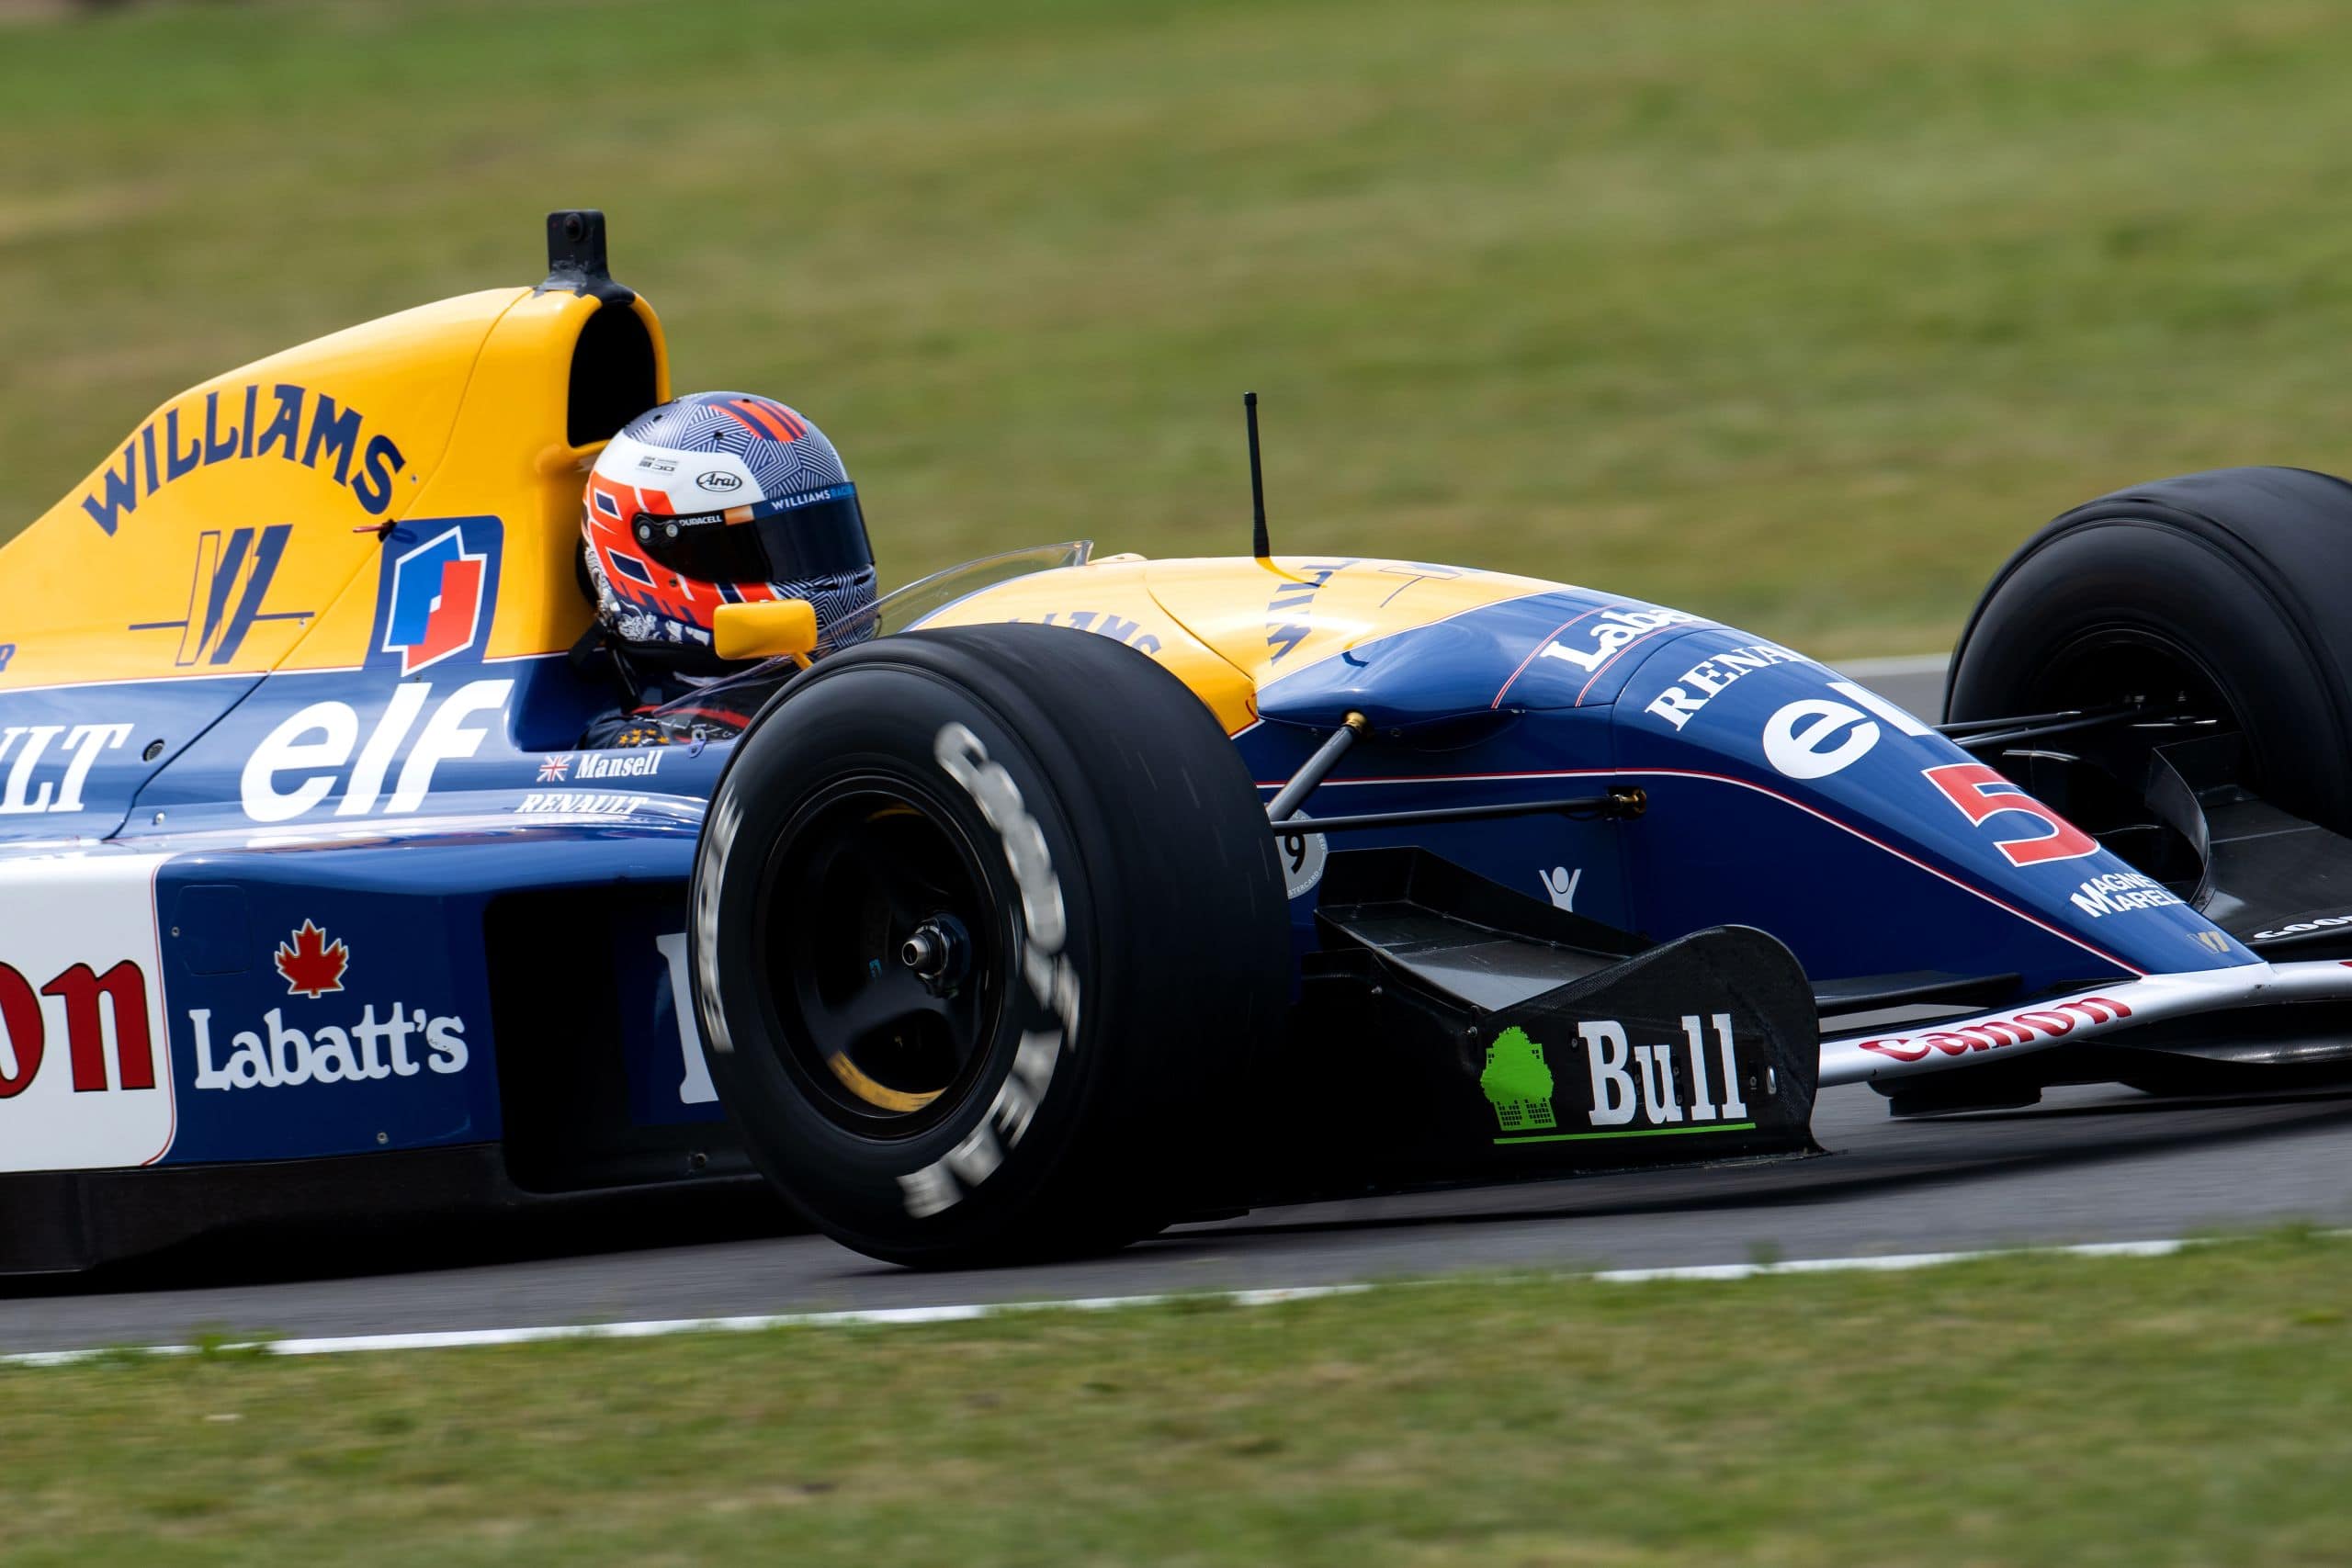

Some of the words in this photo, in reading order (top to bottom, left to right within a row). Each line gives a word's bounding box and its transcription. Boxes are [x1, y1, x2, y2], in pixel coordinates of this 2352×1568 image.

[83, 383, 406, 536] WILLIAMS
[699, 473, 735, 487] Arai
[771, 490, 831, 510] WILLIAMS
[0, 722, 135, 815] LT
[241, 678, 515, 823] elf
[575, 749, 663, 779] Mansell
[514, 793, 650, 815] RENAULT
[1921, 762, 2101, 868] 5
[2254, 915, 2352, 939] GOO
[188, 1002, 469, 1091] Labatt's
[1858, 997, 2132, 1063] Canon
[1577, 1013, 1747, 1127] Bull
